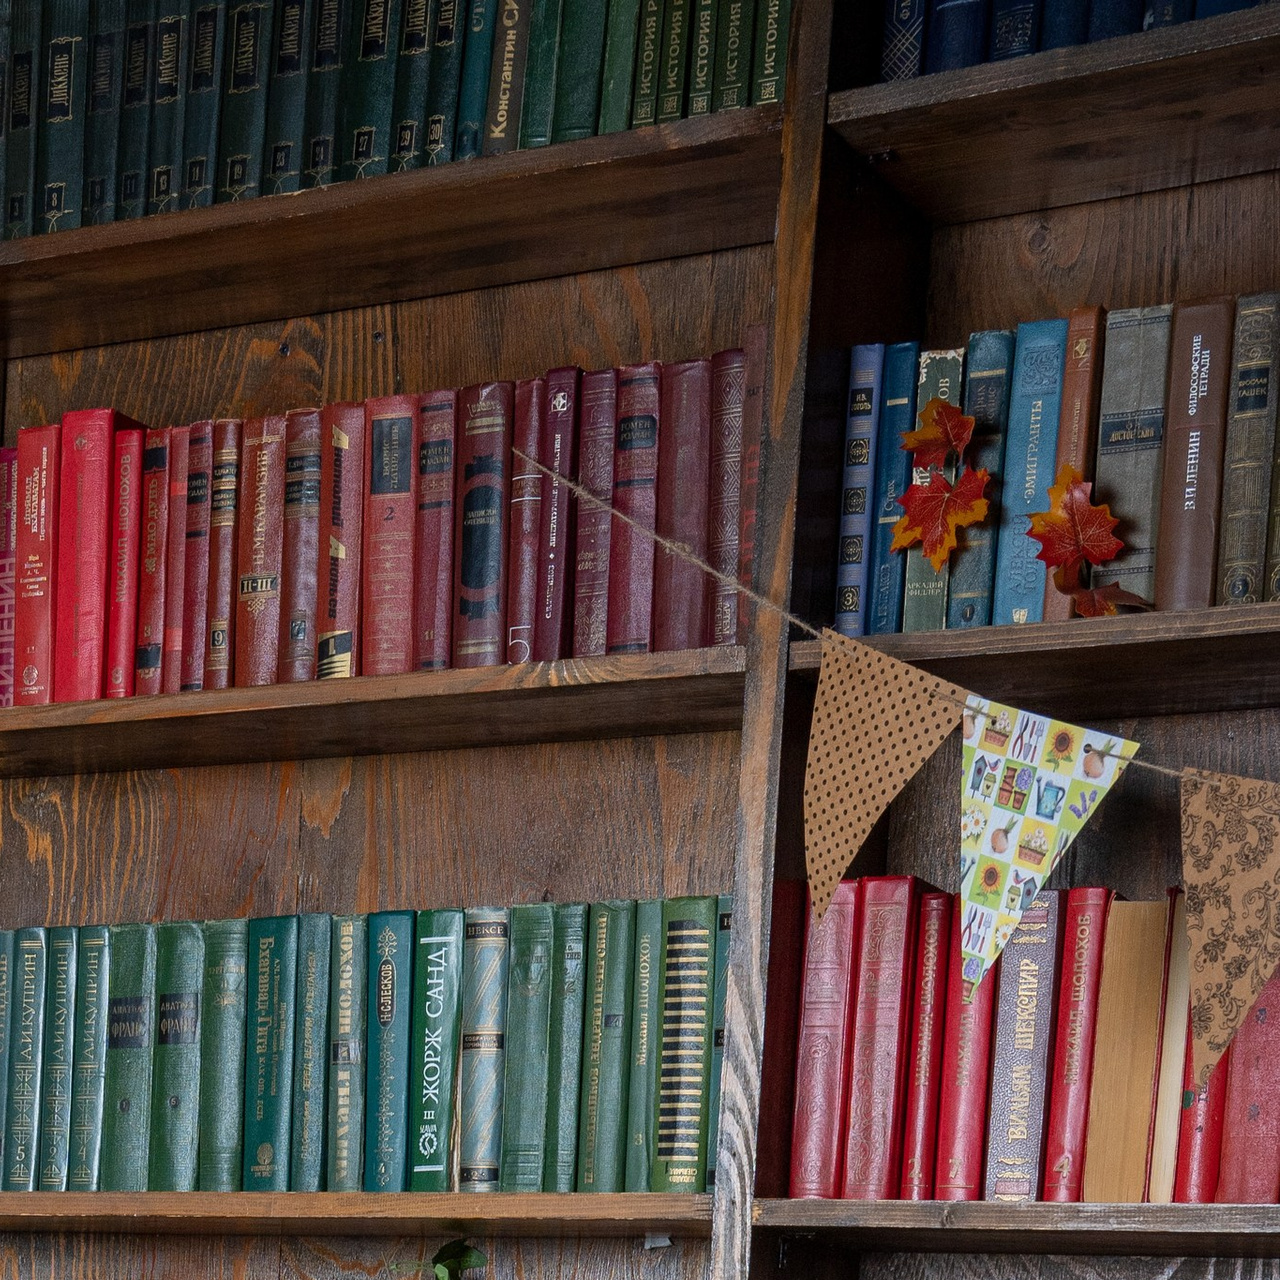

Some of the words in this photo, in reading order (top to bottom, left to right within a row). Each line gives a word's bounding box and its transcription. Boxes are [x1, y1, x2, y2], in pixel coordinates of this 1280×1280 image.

[158, 32, 178, 86] Диккенс
[236, 20, 256, 76] Диккенс
[280, 4, 301, 59] Диккенс
[663, 10, 683, 91] ИСТОРИЯ
[693, 10, 712, 90] ИСТОРИЯ
[723, 3, 742, 83] ИСТОРИЯ
[50, 53, 71, 107] Диккенс
[1187, 334, 1202, 416] ФИЛОСОФСКИЕ
[1198, 348, 1210, 398] ТЕТРАДИ
[1238, 386, 1267, 398] ГАШЕК
[382, 437, 393, 478] БОРИС
[1023, 398, 1043, 499] ЭМИГРАНТЫ
[1183, 429, 1202, 511] В.И.ЛЕНИН
[119, 454, 131, 533] ШОЛОХОВ
[252, 450, 269, 567] Н.М.КАРАМЗИН
[383, 506, 396, 522] 2
[884, 479, 895, 512] Страх
[242, 576, 273, 593] II-III
[843, 592, 853, 606] 3
[507, 625, 532, 664] 5
[467, 925, 505, 936] НЕКСЕ
[921, 918, 939, 1005] ШОЛОХОВ
[1072, 914, 1091, 1002] ШОЛОХОВ
[338, 920, 353, 1035] ШОЛОХОВ
[425, 948, 447, 1018] САНД
[638, 933, 651, 1006] ШОЛОХОВ
[1015, 958, 1040, 1050] ШЕКСПИР
[20, 953, 36, 1061] А.И.КУПРИН
[52, 953, 69, 1061] А.И.КУПРИН
[83, 951, 99, 1061] А.И.КУПРИН
[636, 1008, 648, 1066] Михаил
[422, 1026, 442, 1105] ЖОРЖ
[915, 1011, 933, 1087] МИХАИЛ
[1064, 1009, 1084, 1085] МИХАИЛ
[1007, 1064, 1031, 1144] ВИЛЬЯМ
[16, 1146, 25, 1161] 5
[49, 1146, 57, 1162] 2
[78, 1147, 86, 1162] 4
[908, 1157, 922, 1179] 2
[949, 1157, 961, 1179] 7
[1054, 1156, 1071, 1179] 4
